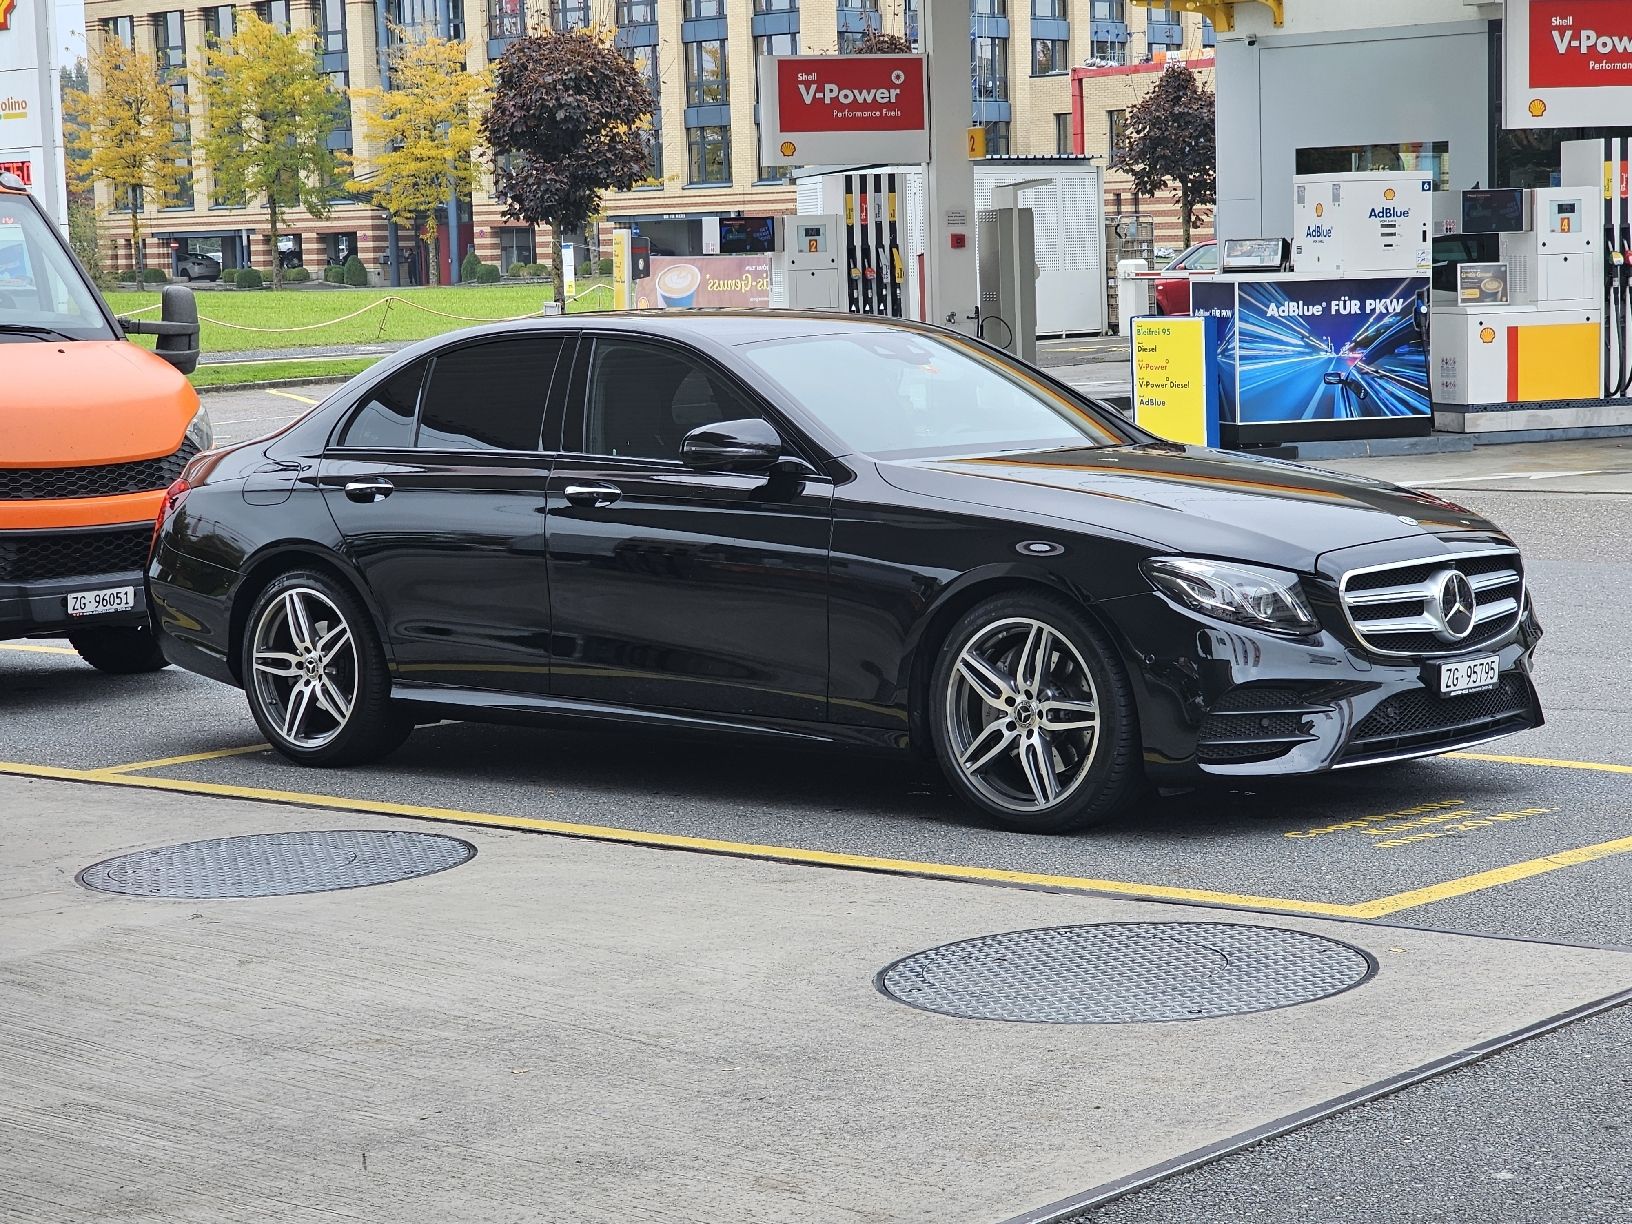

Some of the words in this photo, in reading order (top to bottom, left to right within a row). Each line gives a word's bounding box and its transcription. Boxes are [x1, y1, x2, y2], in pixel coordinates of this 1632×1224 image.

[1551, 16, 1573, 26] Shell
[797, 73, 817, 81] Shell
[797, 83, 901, 105] V-Power
[833, 109, 881, 118] Performance
[882, 108, 901, 117] Fuels
[969, 134, 976, 152] 2
[1561, 218, 1569, 232] 4
[810, 240, 817, 252] 2
[1331, 296, 1362, 315] FÜR
[1365, 298, 1404, 314] PKW
[1161, 328, 1171, 336] 95
[1137, 345, 1157, 353] Diesel
[1138, 363, 1168, 371] V-Power
[1138, 381, 1168, 389] V-Power
[1169, 381, 1190, 389] Diesel
[1139, 398, 1166, 407] AdBlue
